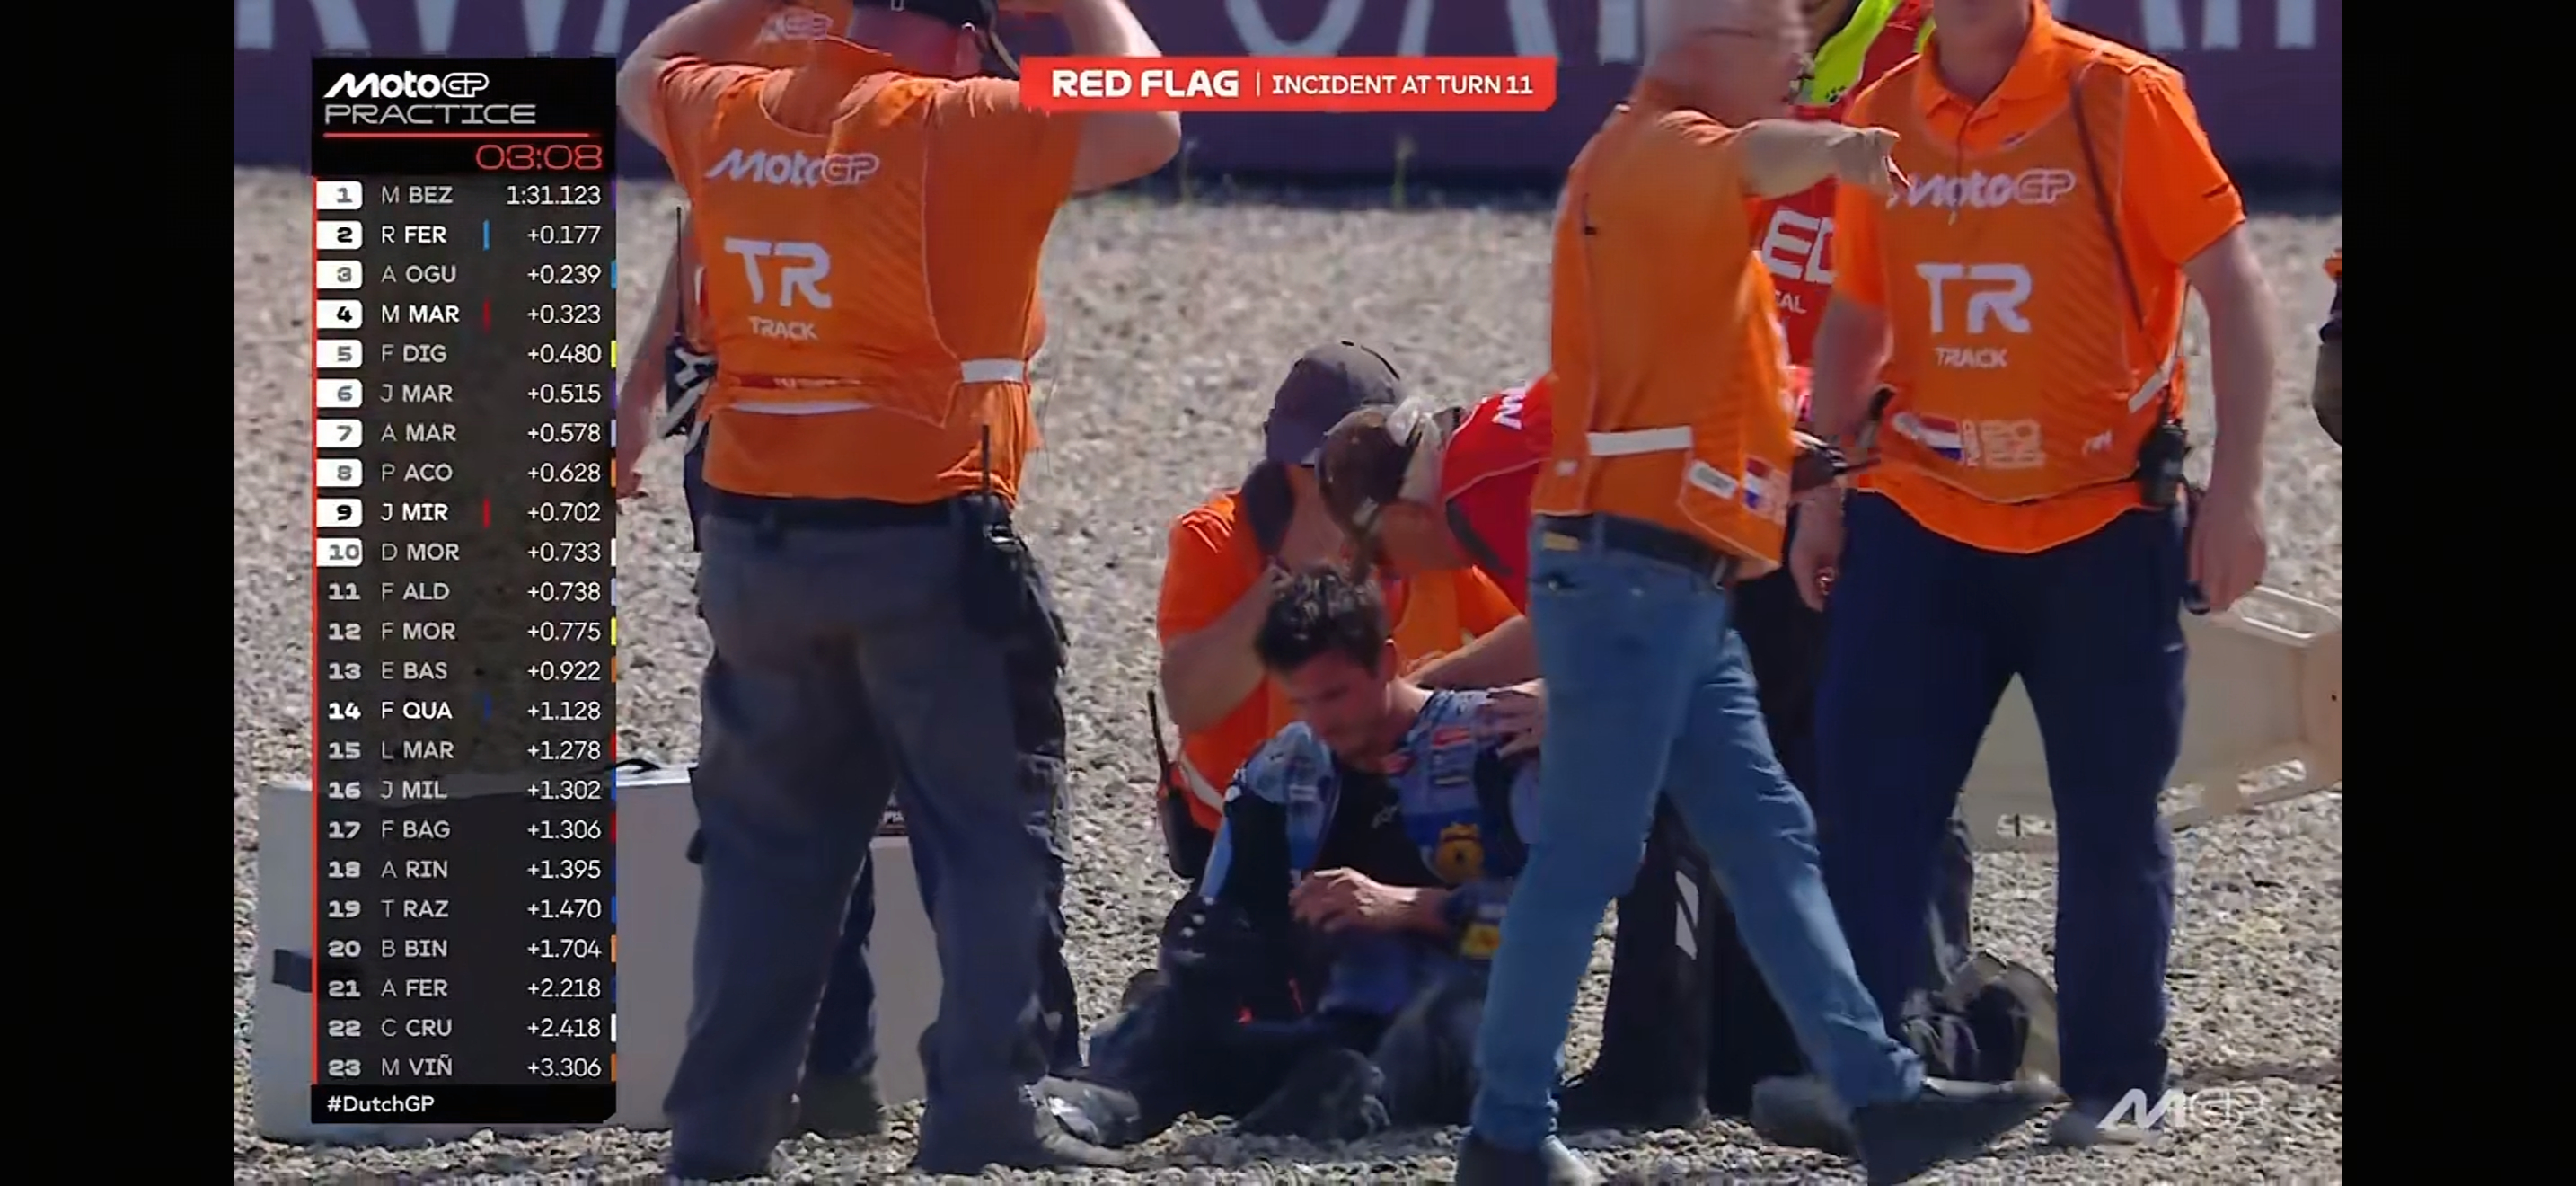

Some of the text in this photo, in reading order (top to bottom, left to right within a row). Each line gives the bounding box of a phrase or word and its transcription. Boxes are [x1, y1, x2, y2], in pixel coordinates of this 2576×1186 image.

[724, 236, 833, 309] TR
[1915, 262, 2033, 334] TR
[748, 315, 818, 341] TRACK
[1935, 345, 2009, 369] TRACK
